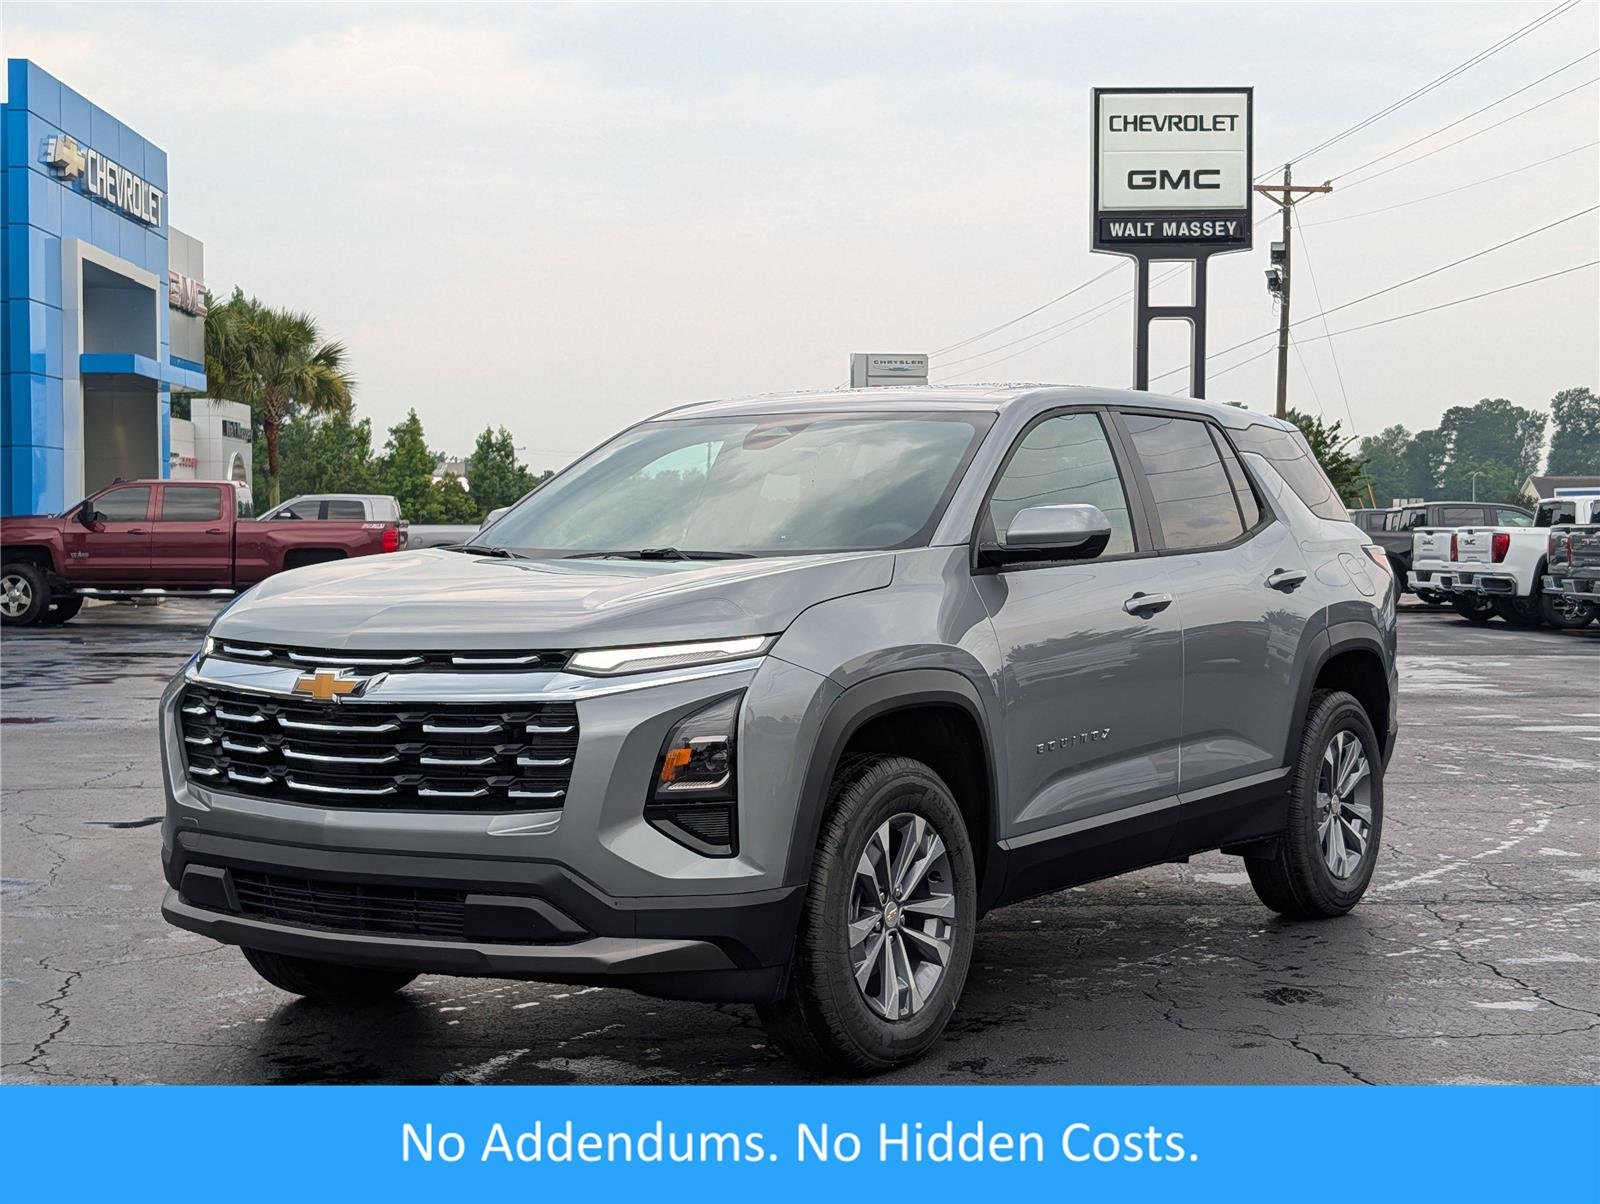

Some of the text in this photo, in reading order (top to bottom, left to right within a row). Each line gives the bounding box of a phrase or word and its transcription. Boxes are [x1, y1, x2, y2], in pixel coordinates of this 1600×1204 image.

[1109, 114, 1239, 132] CHEVROLET
[86, 148, 163, 227] CHEVROLET
[1128, 169, 1221, 190] GMC
[1109, 221, 1237, 237] WALT MASSEY
[169, 271, 208, 316] GMC
[1036, 727, 1111, 755] EQUINOX
